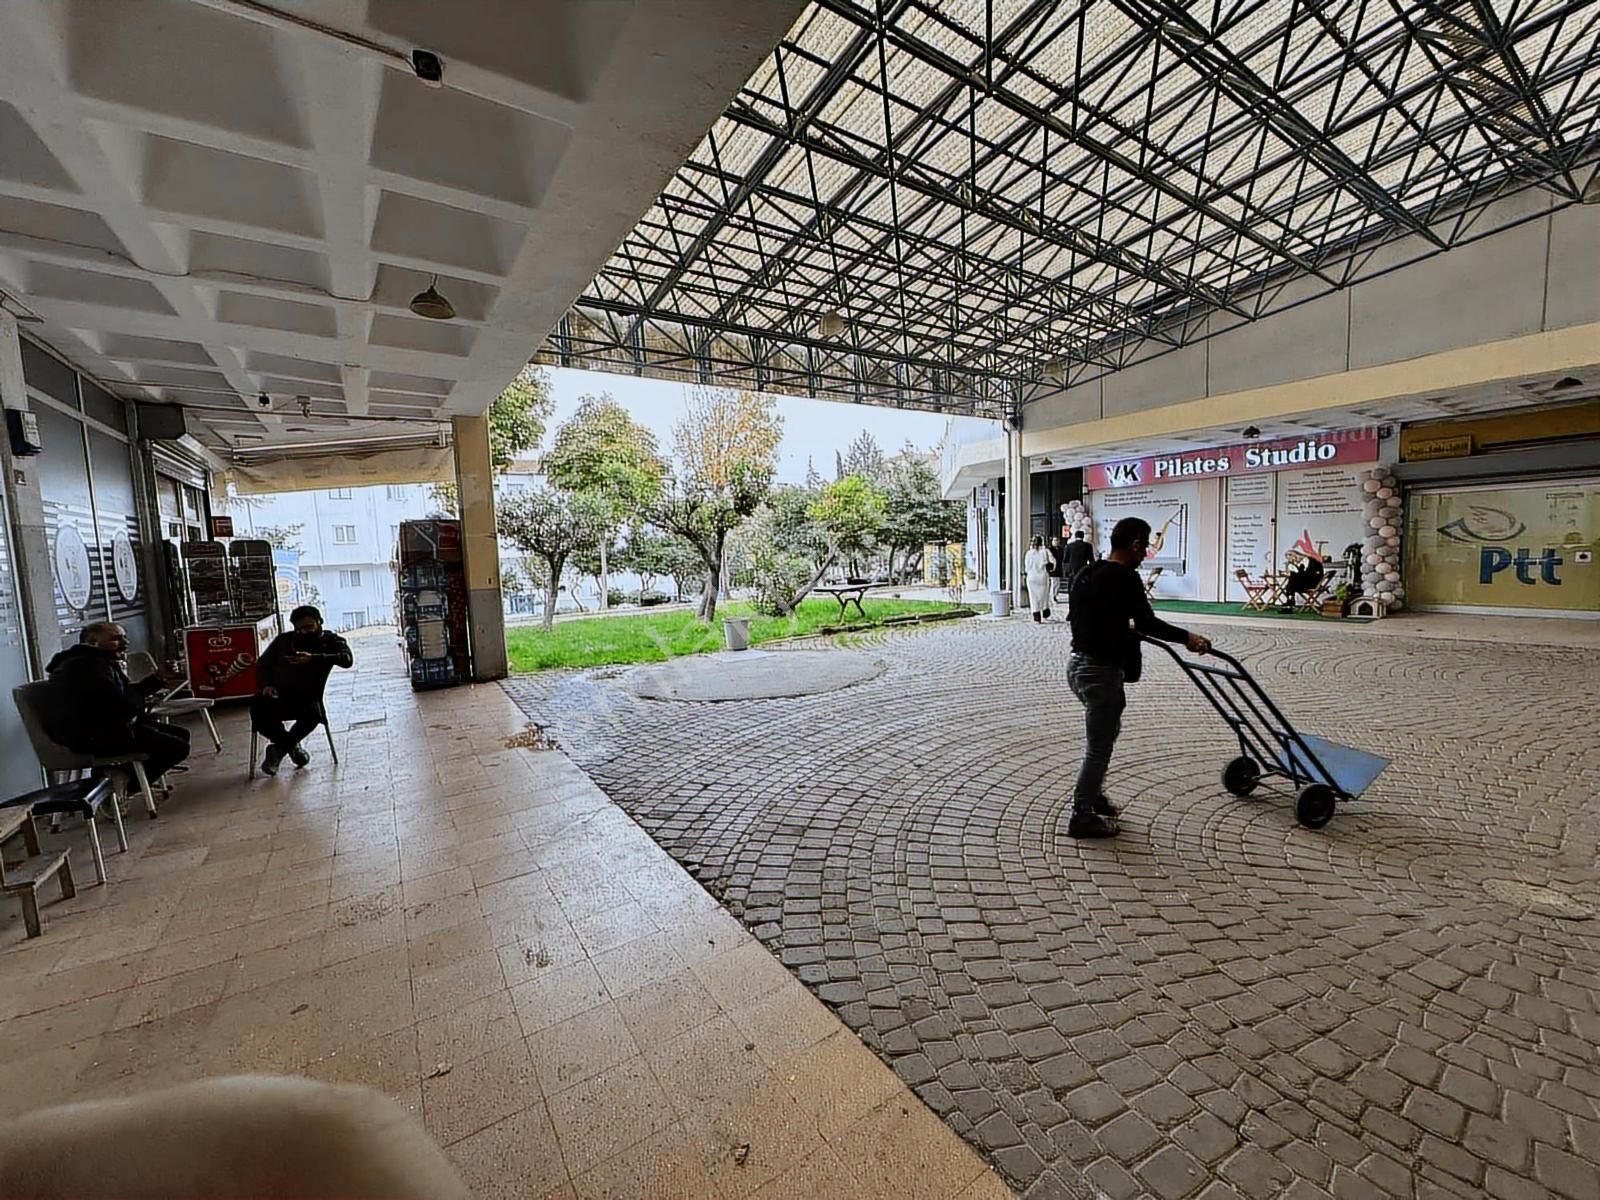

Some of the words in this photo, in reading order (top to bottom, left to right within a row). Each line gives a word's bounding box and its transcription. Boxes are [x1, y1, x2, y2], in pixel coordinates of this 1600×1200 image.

[1154, 456, 1230, 478] Pilates
[1245, 441, 1336, 468] Studio
[1480, 547, 1563, 585] Ptt
